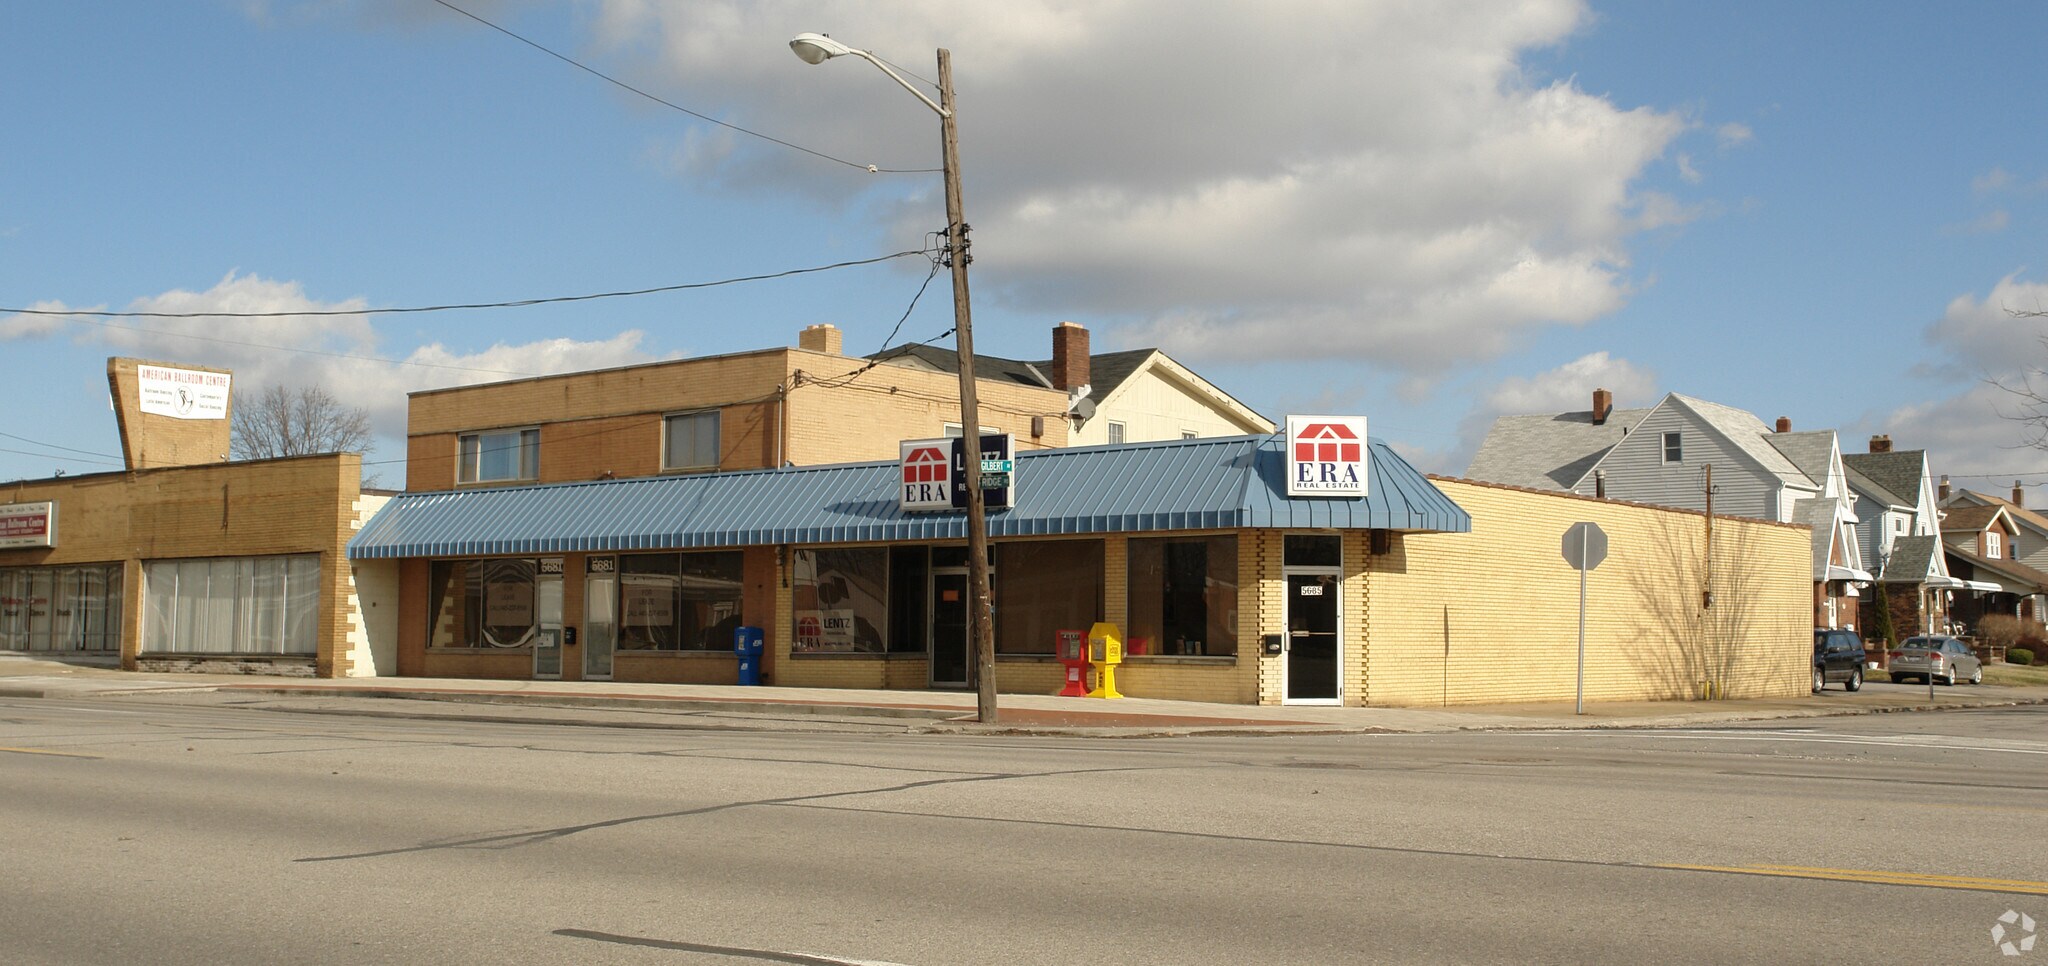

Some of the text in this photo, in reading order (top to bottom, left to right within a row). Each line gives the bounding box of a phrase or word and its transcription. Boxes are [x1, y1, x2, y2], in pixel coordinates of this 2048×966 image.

[142, 369, 227, 387] AMERICAN BALLROOM CENTRE
[980, 461, 1004, 471] GILBERT
[1297, 463, 1359, 483] ERA
[981, 477, 1002, 487] RIDGE
[905, 483, 946, 502] ERA
[541, 562, 563, 572] 5681
[591, 560, 614, 571] 5681
[1301, 587, 1323, 595] 5685
[823, 618, 851, 628] LENTZ
[799, 637, 821, 648] ERA
